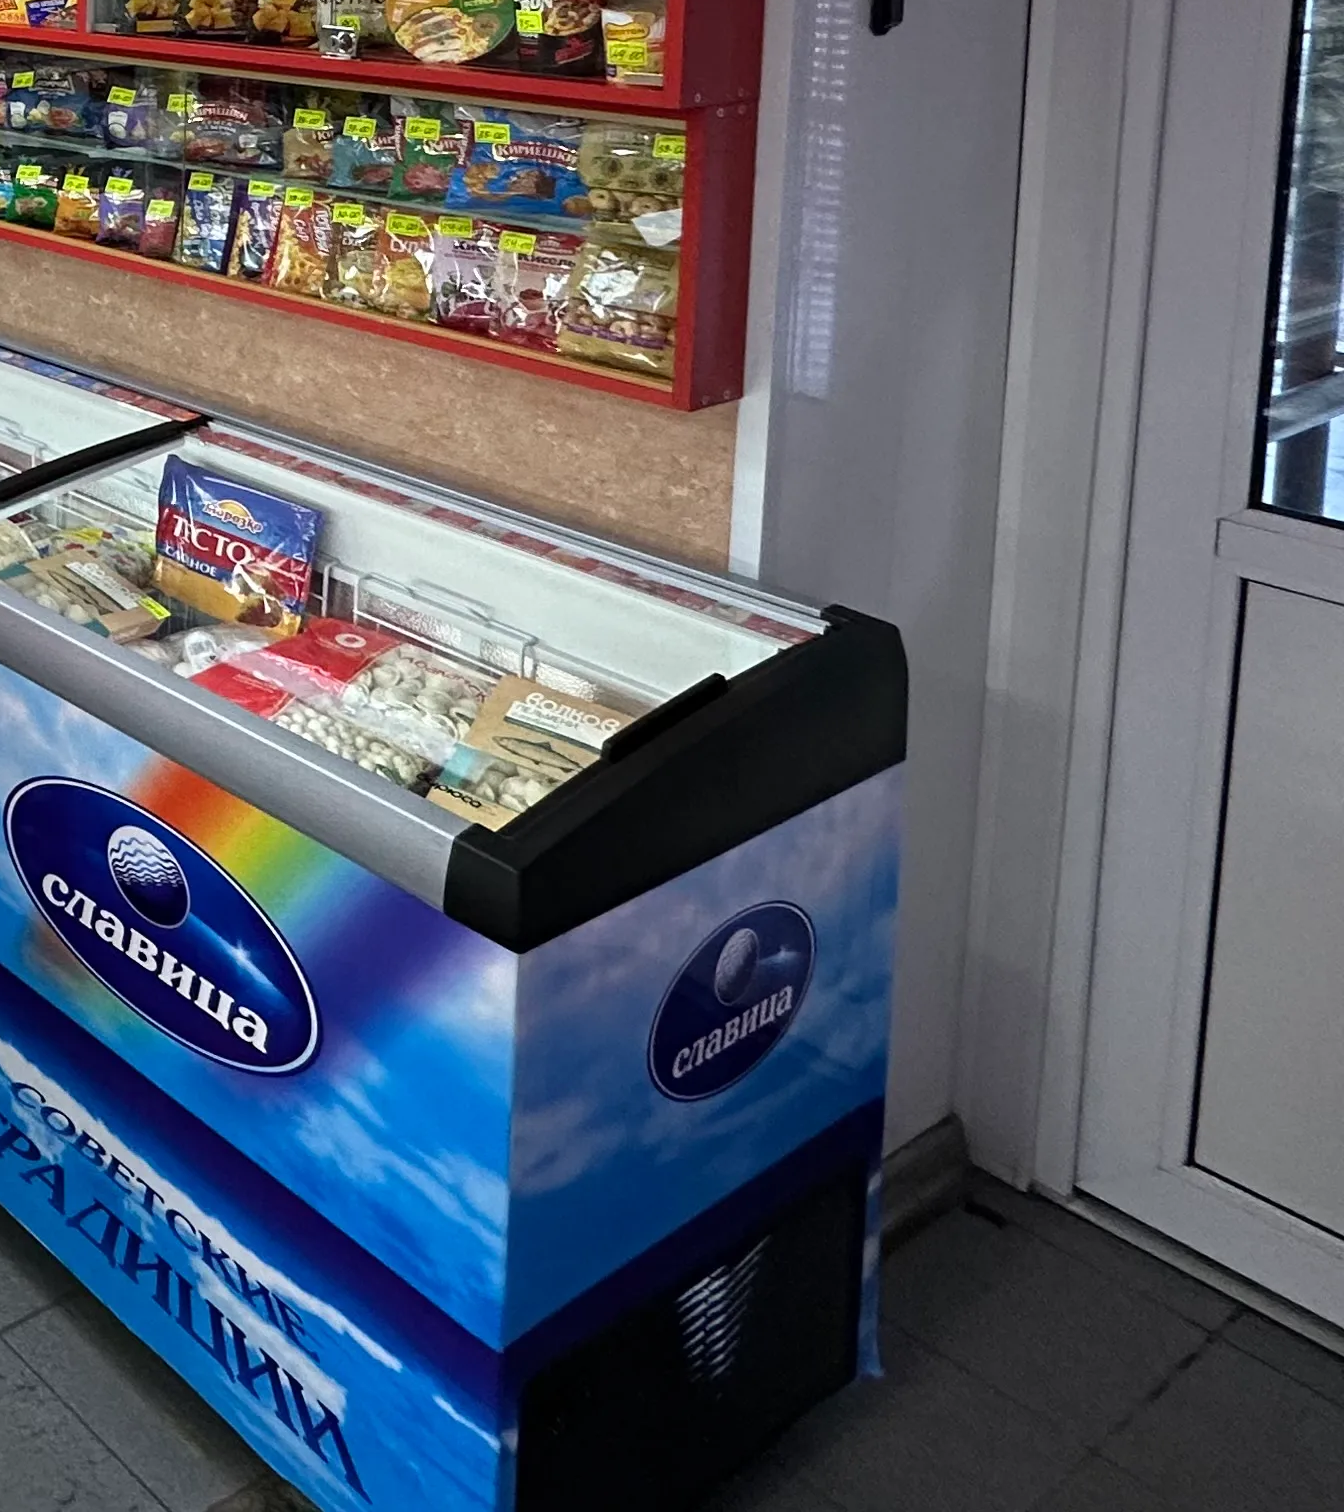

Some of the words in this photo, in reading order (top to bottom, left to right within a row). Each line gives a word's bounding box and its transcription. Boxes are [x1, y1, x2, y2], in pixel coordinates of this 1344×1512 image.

[171, 515, 254, 564] ТЕСТО
[42, 872, 271, 1053] славица
[671, 986, 794, 1079] славица
[12, 1079, 308, 1340] СОВЕТСКИЕ
